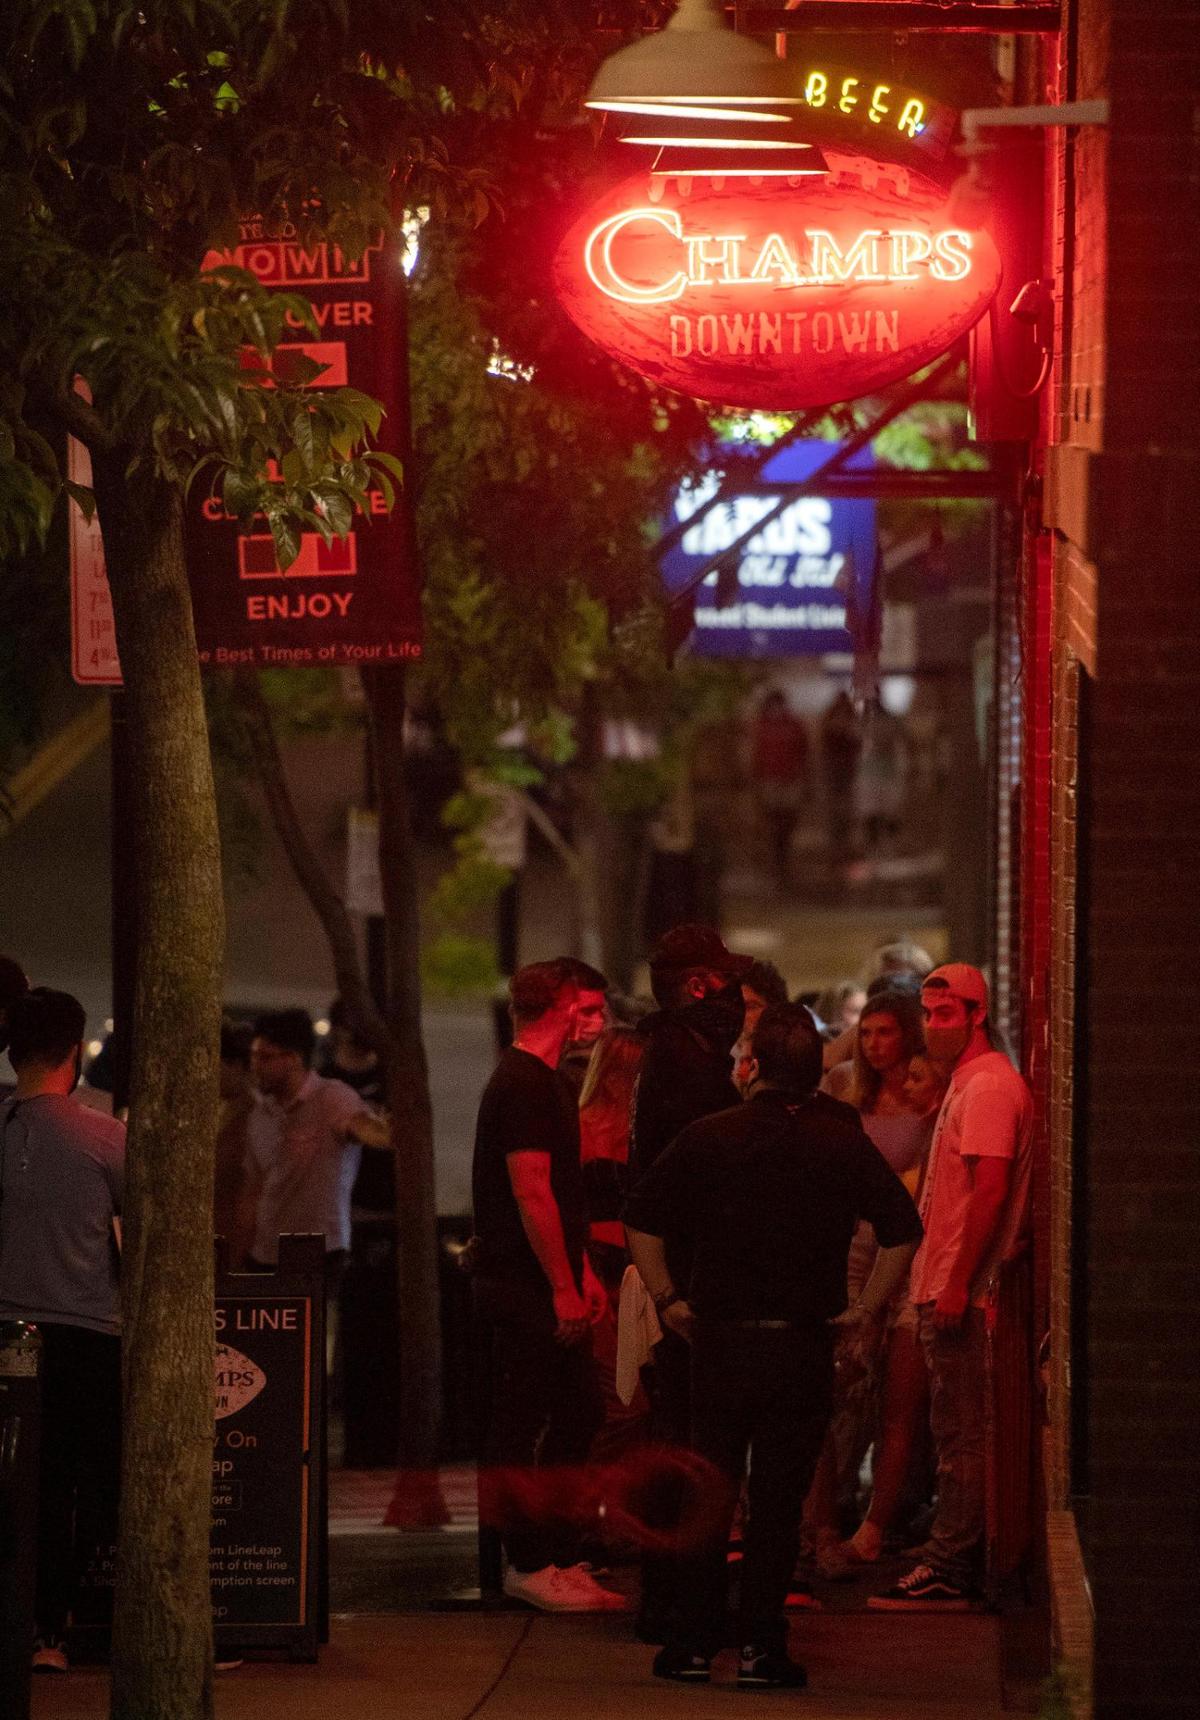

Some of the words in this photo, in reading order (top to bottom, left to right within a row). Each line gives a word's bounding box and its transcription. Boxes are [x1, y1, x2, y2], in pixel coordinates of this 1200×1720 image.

[804, 70, 926, 138] BEER
[669, 308, 900, 359] DOWNTOWN
[246, 592, 353, 620] ENJOY
[215, 646, 254, 662] Best
[260, 644, 313, 661] Times
[318, 643, 337, 660] of
[342, 642, 382, 658] Your
[387, 640, 422, 657] Life
[236, 1308, 298, 1330] LINE
[226, 1430, 257, 1448] On
[227, 1543, 282, 1559] LineLeap
[227, 1558, 241, 1571] of
[243, 1559, 263, 1571] the
[266, 1559, 288, 1571] line
[255, 1576, 296, 1586] screen
